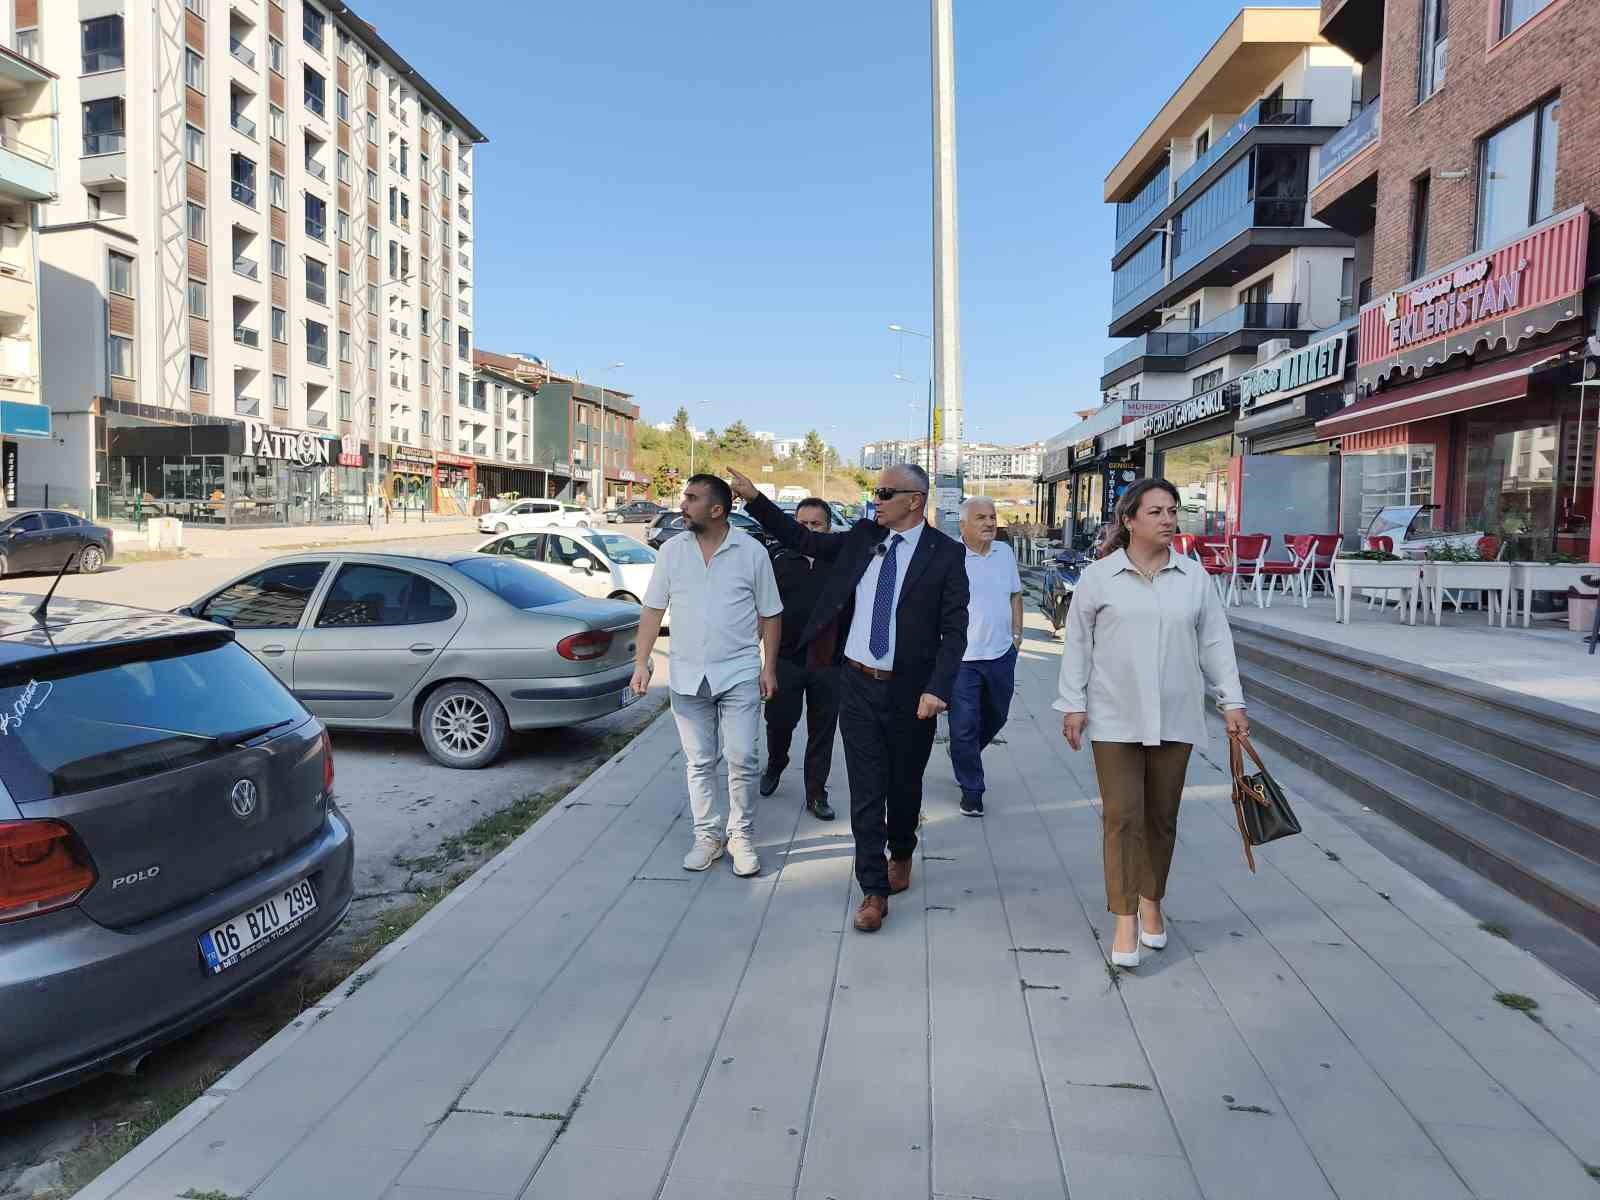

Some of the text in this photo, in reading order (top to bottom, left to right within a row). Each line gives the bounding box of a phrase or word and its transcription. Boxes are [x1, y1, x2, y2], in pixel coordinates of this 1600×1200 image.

[1280, 339, 1337, 392] MARKET
[242, 421, 330, 466] PATRON
[112, 866, 160, 889] POLO
[214, 882, 313, 957] 06 BZU 299
